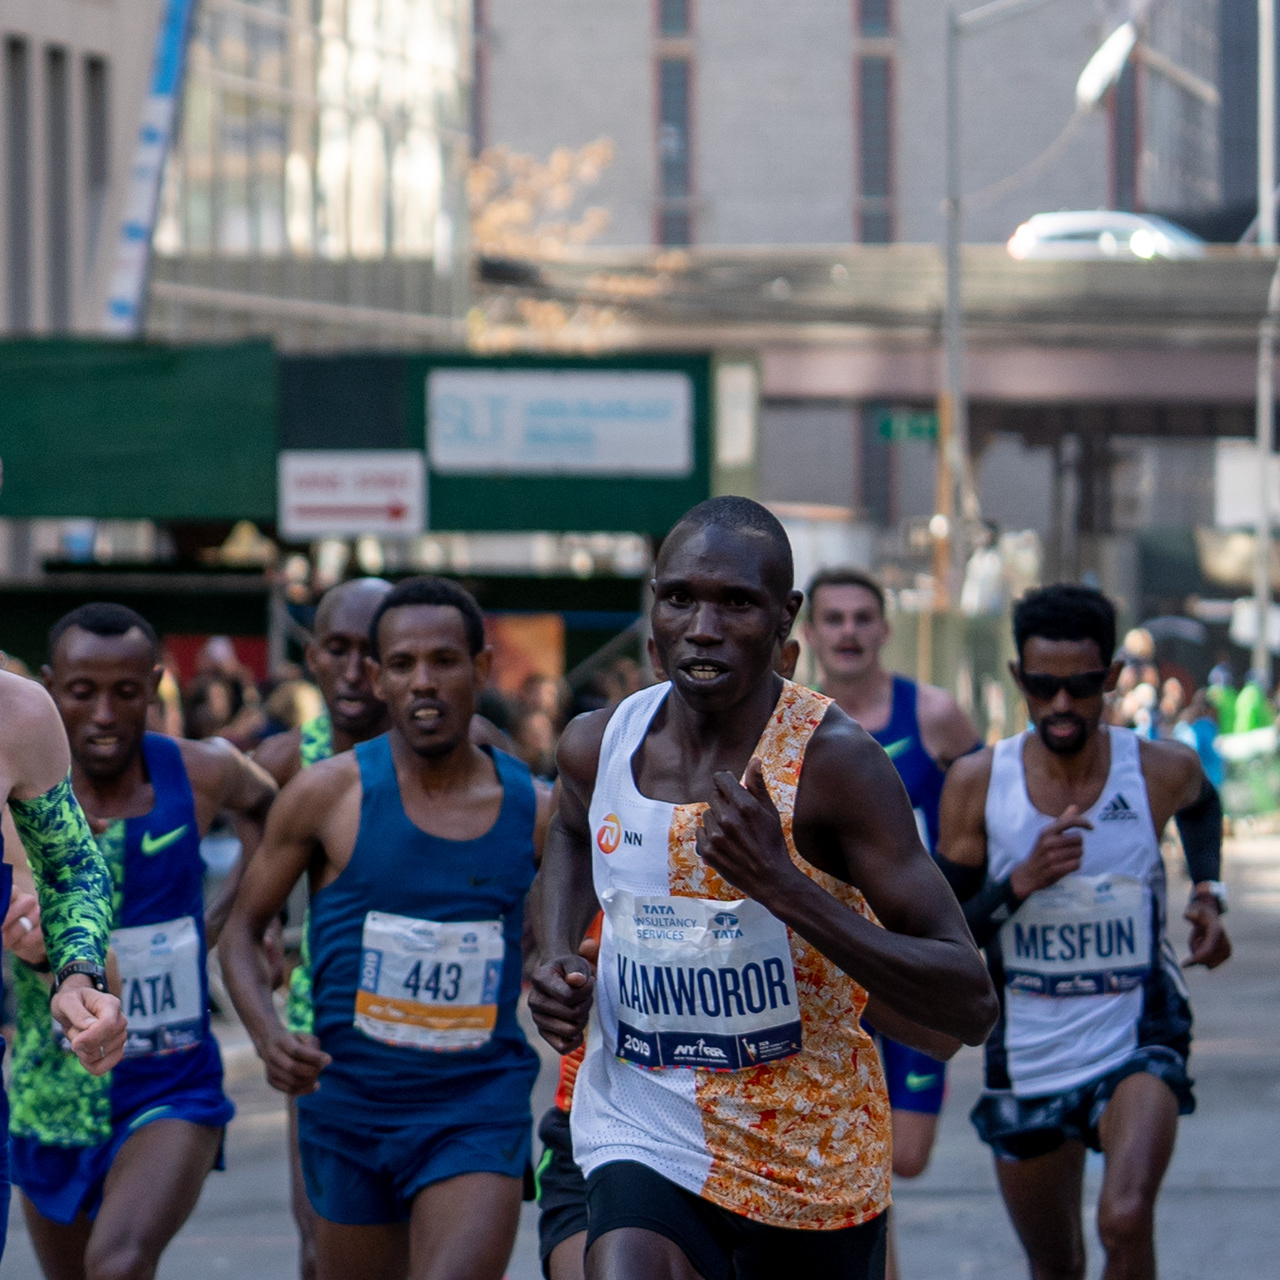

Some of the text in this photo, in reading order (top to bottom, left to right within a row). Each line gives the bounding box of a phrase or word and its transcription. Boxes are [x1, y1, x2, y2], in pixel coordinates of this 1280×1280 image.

[624, 830, 643, 846] NN
[642, 905, 675, 915] TATA
[637, 929, 684, 940] SERVICES
[712, 929, 744, 939] TATA
[1014, 916, 1135, 961] MESFUN
[404, 960, 462, 1001] 443
[617, 953, 790, 1018] KAMWOROR
[123, 972, 176, 1016] ATA
[624, 1034, 651, 1057] 2019
